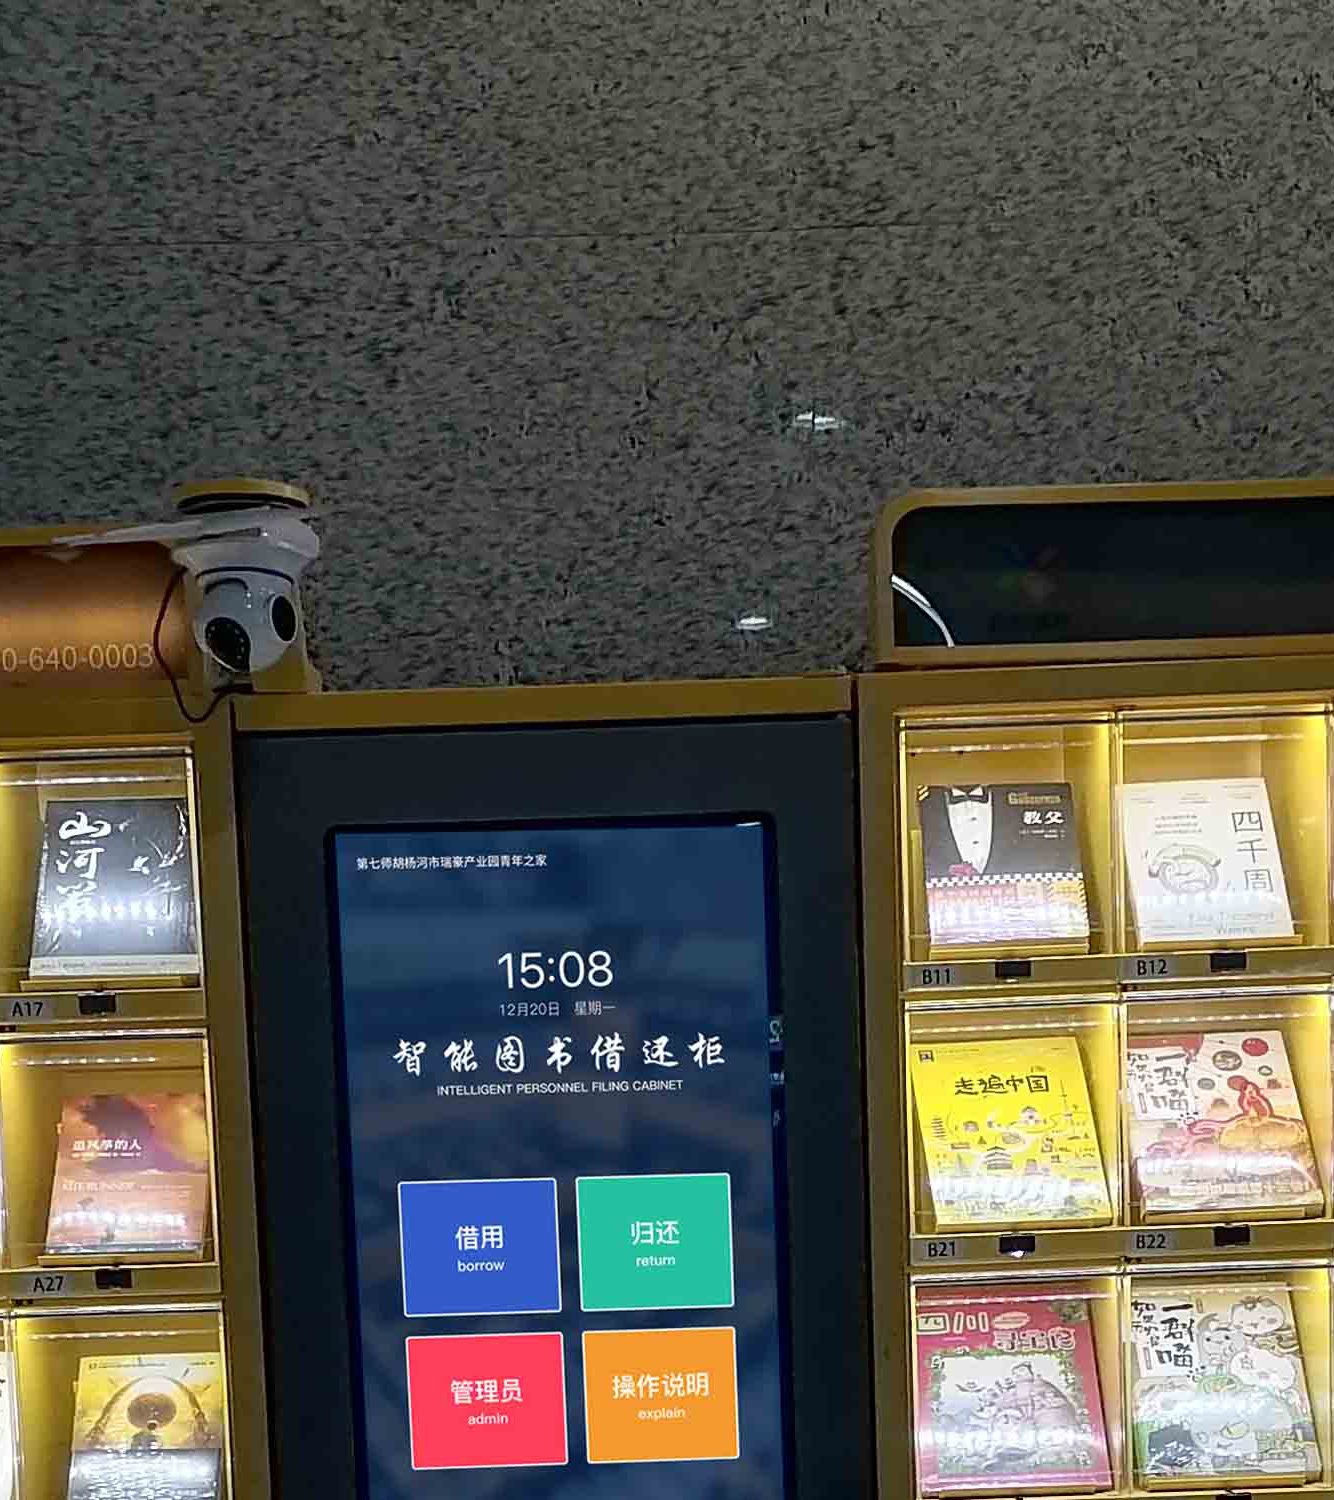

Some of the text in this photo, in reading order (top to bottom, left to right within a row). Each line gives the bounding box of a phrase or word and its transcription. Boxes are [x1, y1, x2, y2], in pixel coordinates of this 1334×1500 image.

[1231, 810, 1275, 894] 四千周
[355, 853, 548, 871] 第七师胡杨河市瑞豪产业园青年之家
[497, 950, 614, 989] 15:08
[1136, 959, 1168, 976] B12
[922, 969, 952, 985] B11
[11, 1002, 44, 1017] A17
[499, 1000, 616, 1017] 12月20日 星期一
[392, 1030, 726, 1077] 智能图书借还柜
[436, 1079, 684, 1097] INTELLIGENT PERSONNEL FILING CABINET
[954, 1073, 1050, 1097] 走遍中国
[454, 1225, 505, 1251] 借用
[630, 1220, 681, 1246] 归还
[1135, 1234, 1167, 1250] B22
[927, 1242, 957, 1258] B21
[456, 1258, 505, 1273] borrow
[635, 1254, 676, 1268] return
[33, 1276, 65, 1293] A27
[916, 1311, 990, 1333] 四川
[1156, 1303, 1195, 1370] 一群喵
[449, 1378, 524, 1405] 管理员
[611, 1371, 710, 1401] 操作说明
[467, 1412, 509, 1425] admin
[637, 1406, 687, 1422] explain
